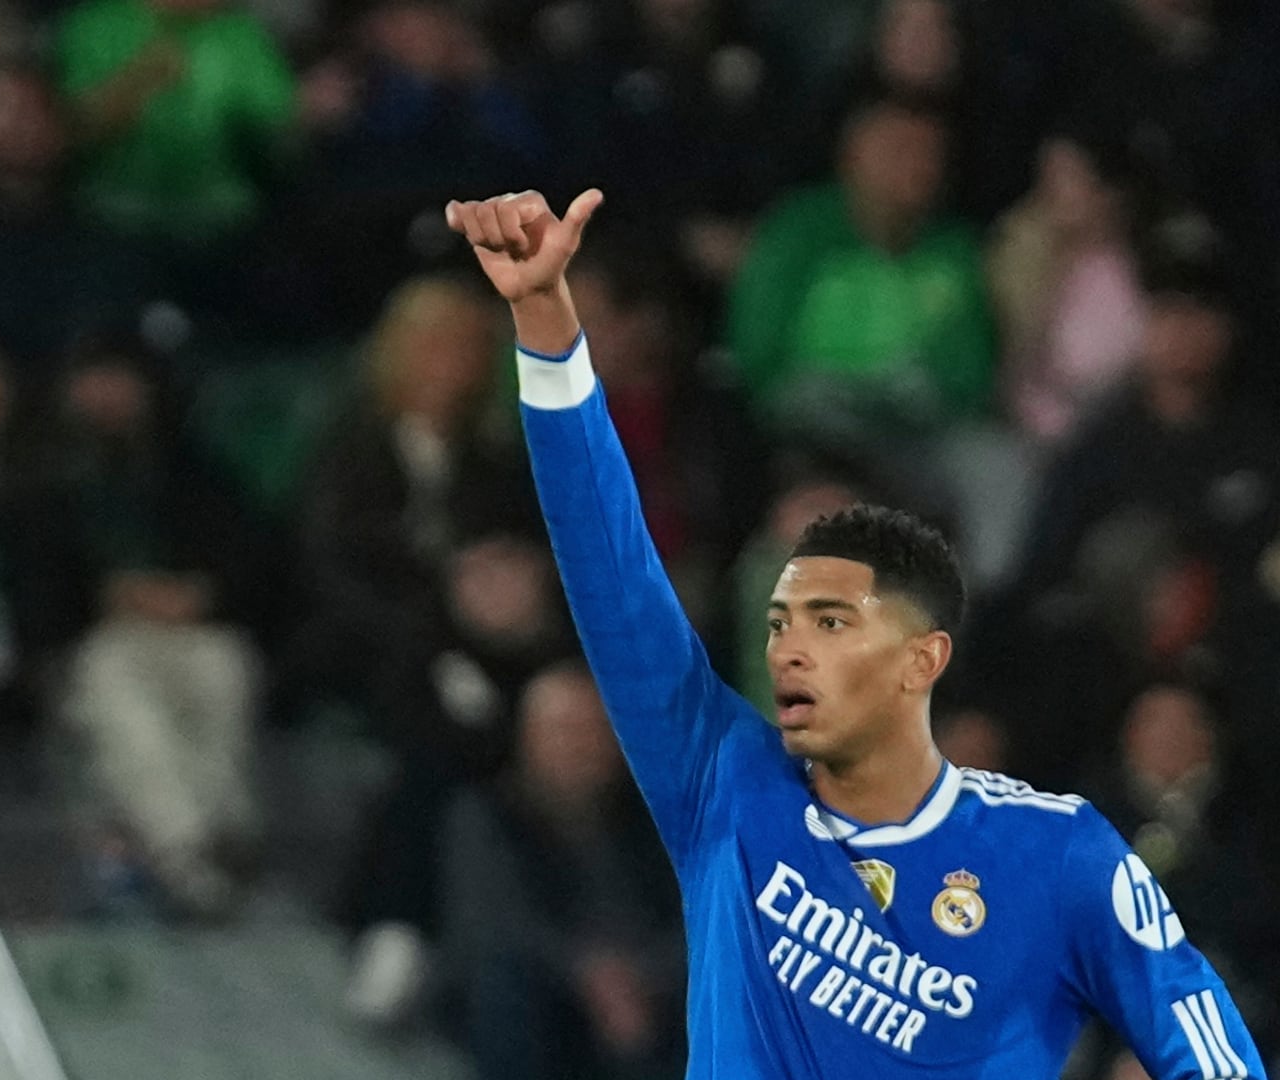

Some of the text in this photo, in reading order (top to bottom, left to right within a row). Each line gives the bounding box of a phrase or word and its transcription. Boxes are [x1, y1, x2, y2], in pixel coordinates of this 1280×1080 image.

[756, 860, 978, 1018] Emirates
[1121, 855, 1179, 950] hp
[768, 935, 927, 1053] FLY BETTER
